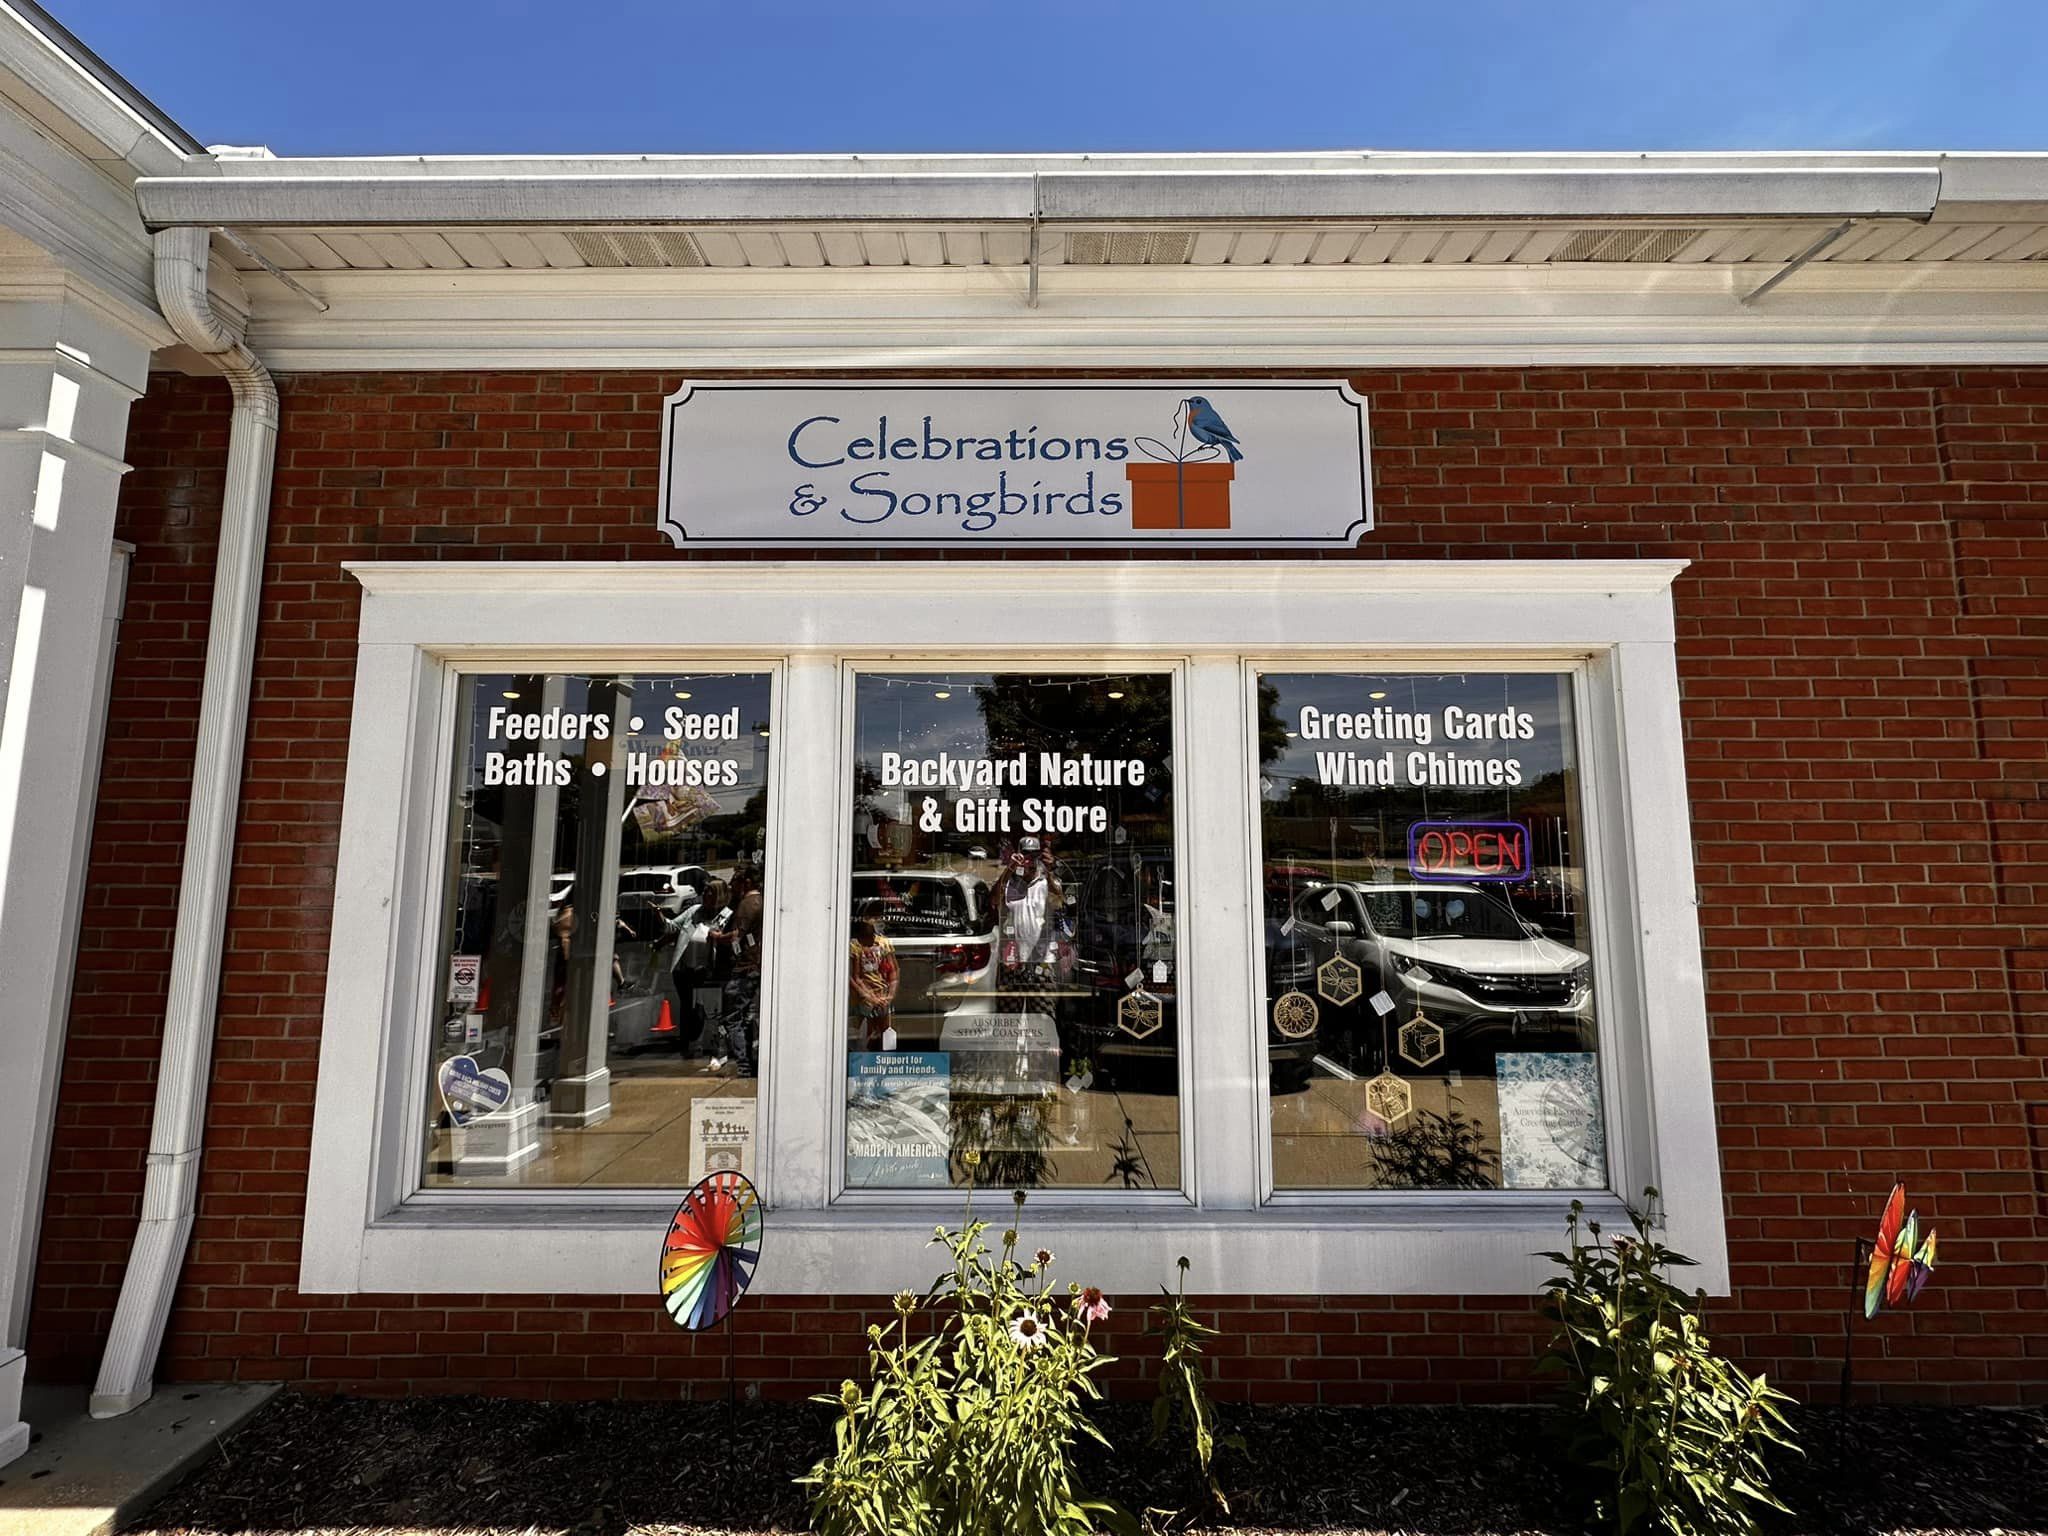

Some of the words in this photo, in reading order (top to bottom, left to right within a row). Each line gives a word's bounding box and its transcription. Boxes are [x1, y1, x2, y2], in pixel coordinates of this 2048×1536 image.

[787, 415, 1130, 469] Celebrations
[788, 483, 828, 516] &
[840, 471, 1123, 531] Songbirds
[488, 706, 610, 740] Feeders
[664, 706, 739, 740] Seed
[1300, 705, 1432, 745] Greeting
[1444, 705, 1535, 740] Cards
[484, 751, 572, 786] Baths
[626, 751, 738, 786] Houses
[881, 752, 1027, 791] Backyard
[1040, 752, 1145, 786] Nature
[1315, 751, 1395, 786] Wind
[1407, 751, 1522, 786] Chimes
[919, 797, 943, 832] &
[955, 797, 1011, 832] Gift
[1022, 797, 1107, 832] Store
[1418, 831, 1521, 871] OPEN
[860, 1065, 887, 1075] family
[888, 1065, 904, 1074] and
[906, 1065, 936, 1074] friends
[875, 1055, 909, 1065] Support
[911, 1055, 923, 1065] for
[856, 1143, 882, 1157] MADE
[883, 1143, 894, 1157] IN
